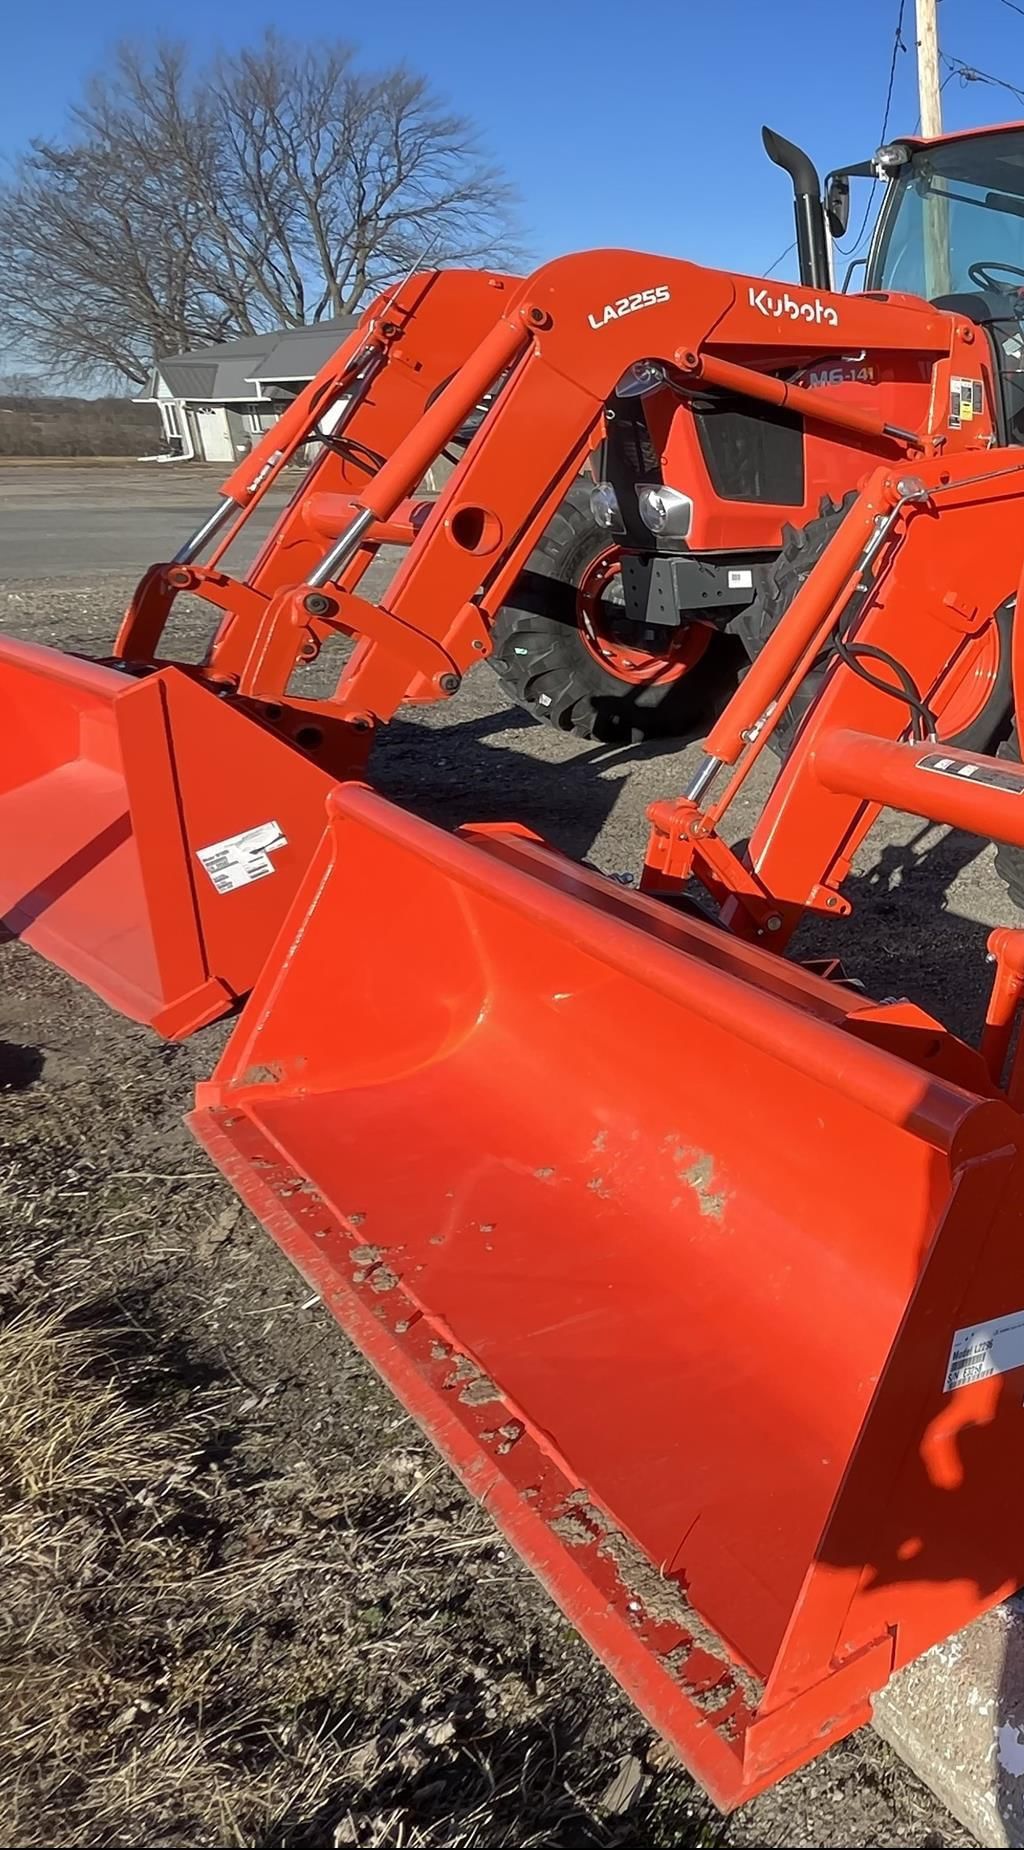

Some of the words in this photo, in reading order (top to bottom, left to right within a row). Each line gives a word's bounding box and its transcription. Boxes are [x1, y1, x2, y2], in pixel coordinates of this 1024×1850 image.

[587, 285, 672, 330] LA2255
[748, 287, 839, 327] Kubota
[809, 367, 874, 389] M6-141
